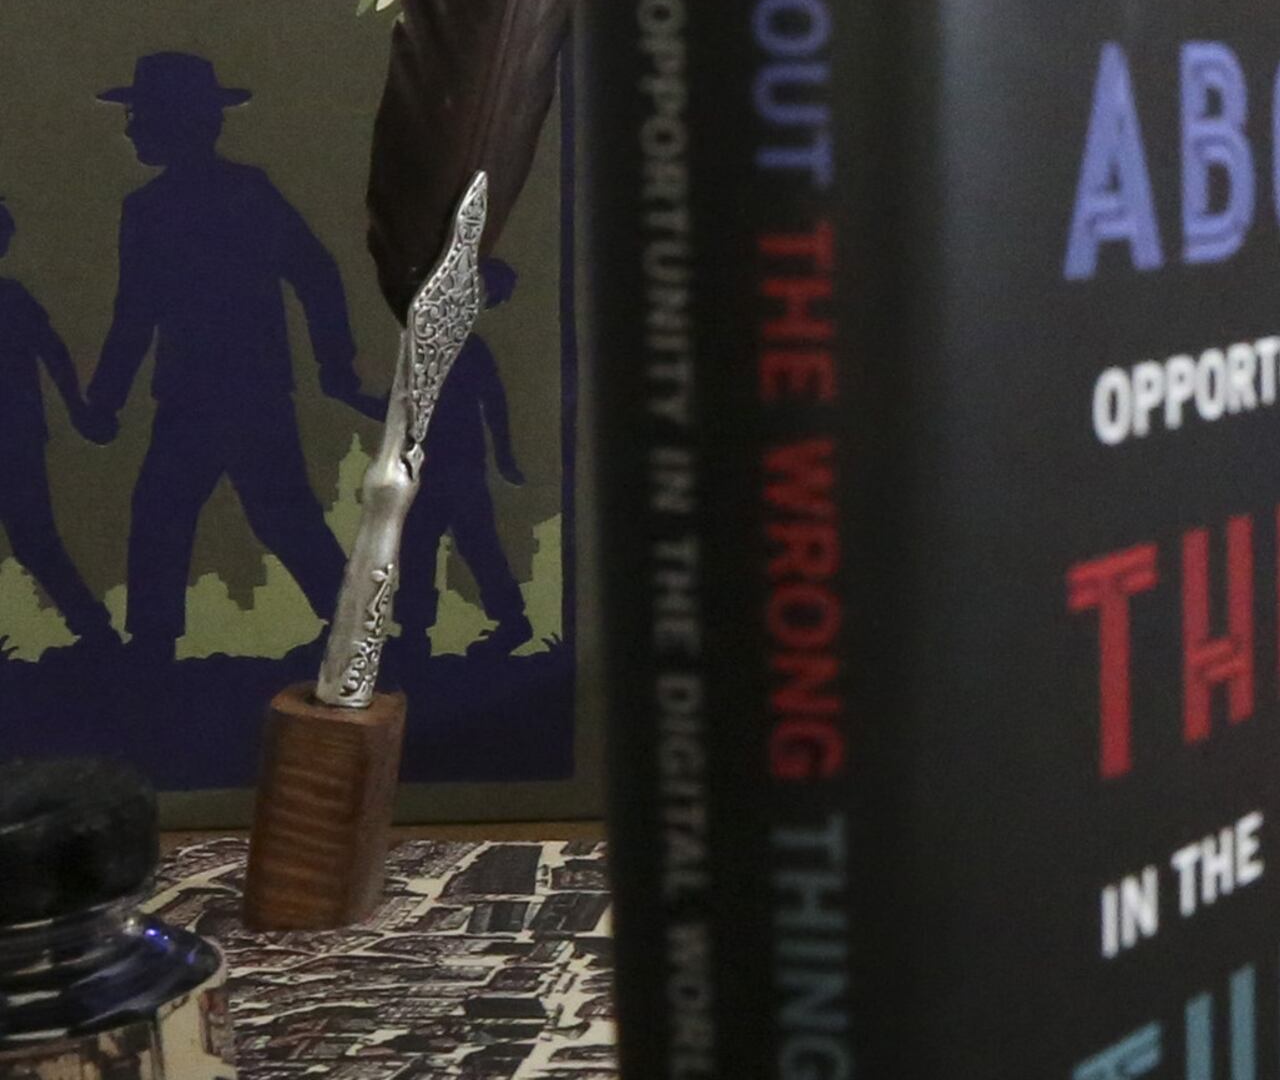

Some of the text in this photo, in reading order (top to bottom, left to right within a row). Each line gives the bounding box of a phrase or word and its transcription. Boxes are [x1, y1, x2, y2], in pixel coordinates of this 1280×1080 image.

[758, 221, 836, 402] THE
[650, 447, 696, 512] IN
[653, 535, 700, 658] THE
[762, 435, 846, 782] WRONG
[656, 674, 710, 905] DIGITAL
[1100, 811, 1265, 960] IN THE
